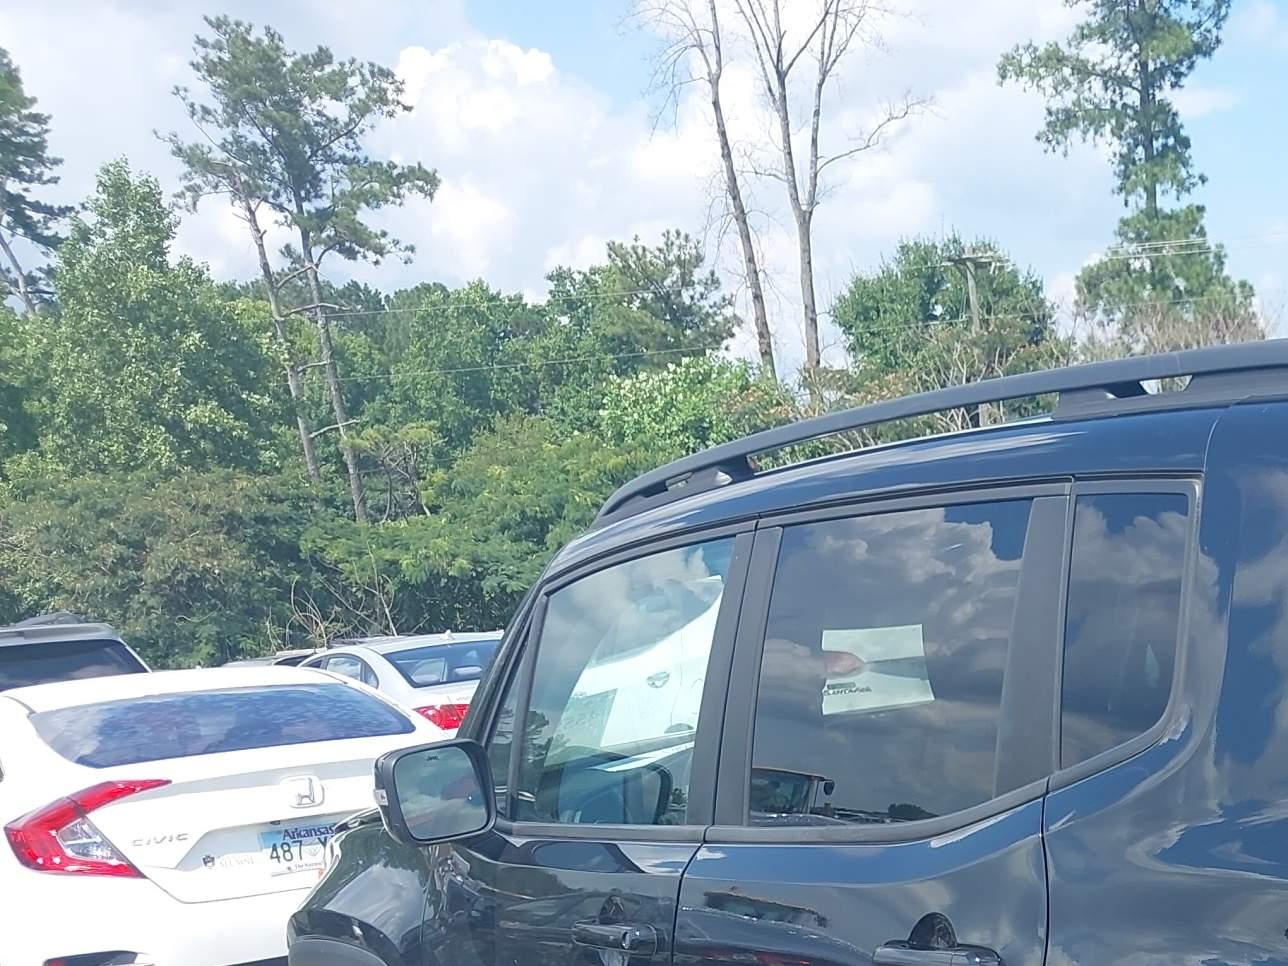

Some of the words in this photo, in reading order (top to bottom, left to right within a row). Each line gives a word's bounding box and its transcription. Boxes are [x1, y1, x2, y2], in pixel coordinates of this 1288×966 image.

[132, 833, 189, 847] CIVIC
[282, 824, 335, 841] Arkansas
[269, 840, 304, 864] 487
